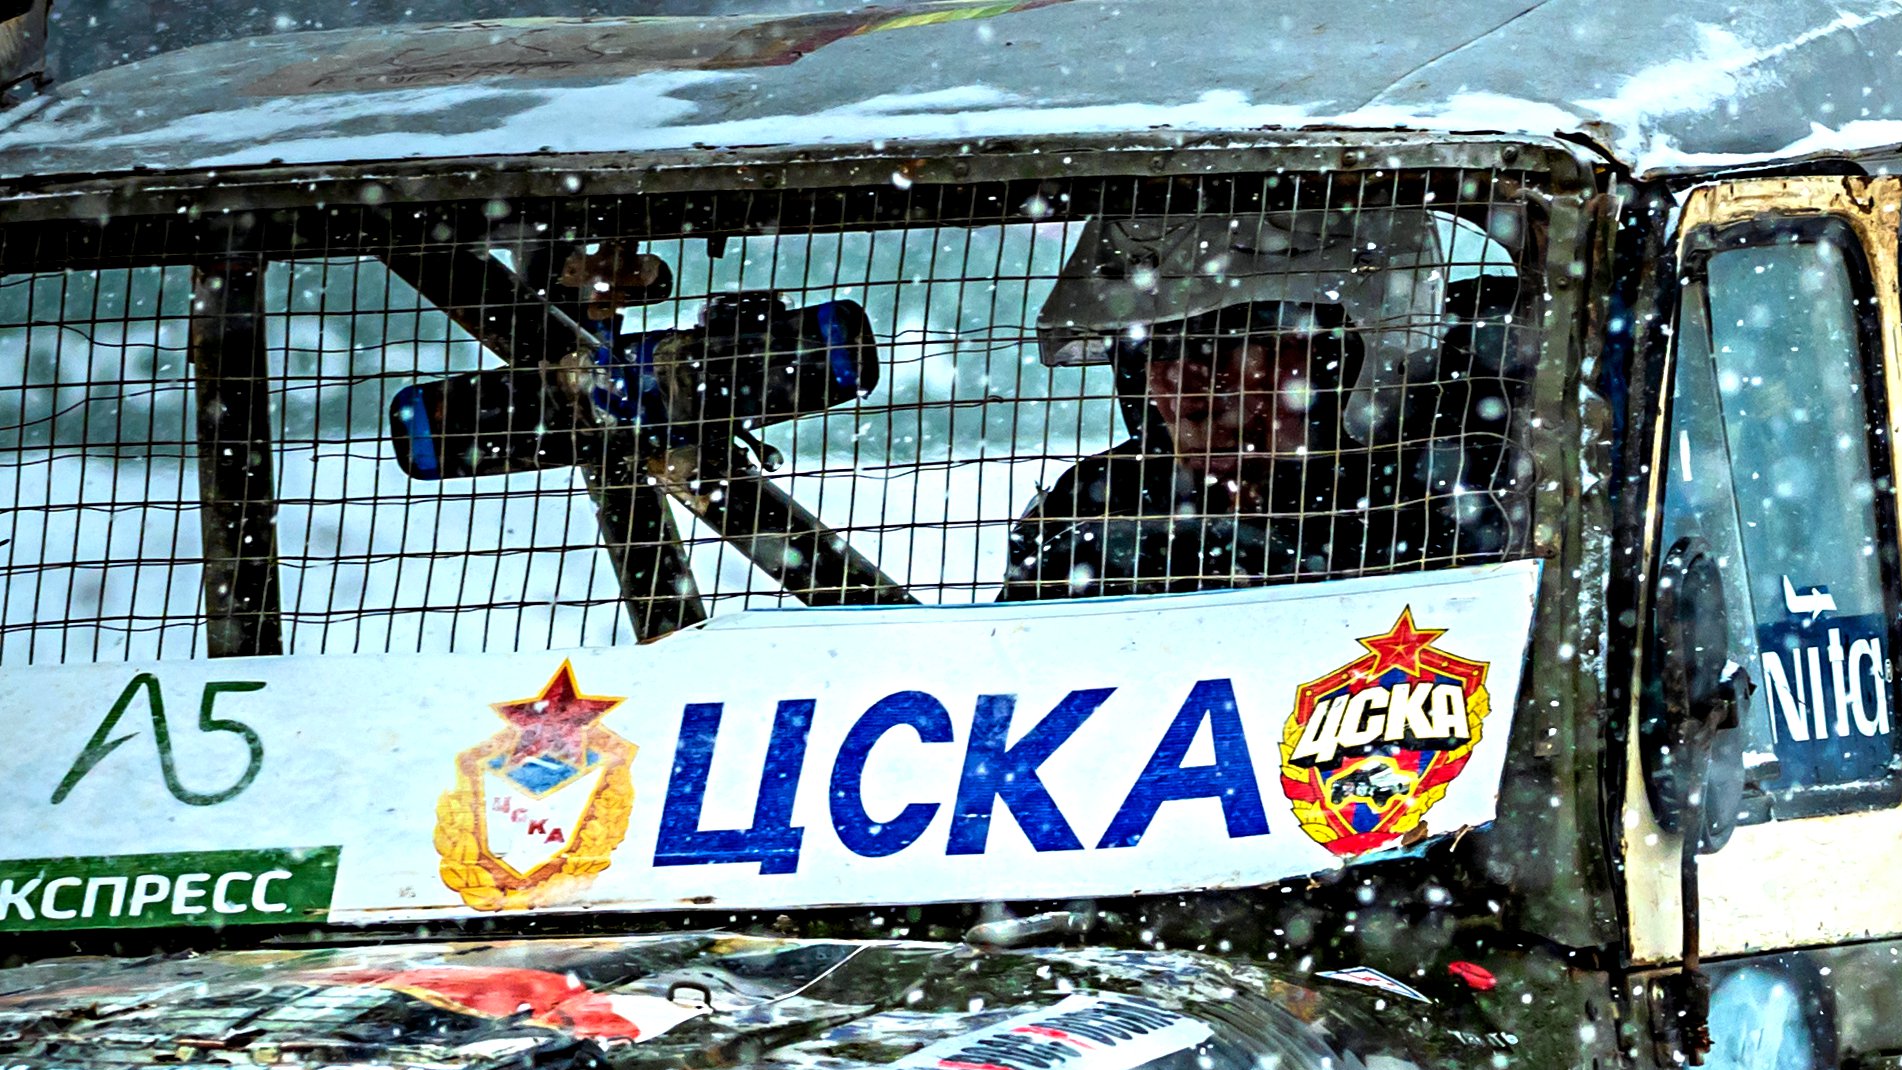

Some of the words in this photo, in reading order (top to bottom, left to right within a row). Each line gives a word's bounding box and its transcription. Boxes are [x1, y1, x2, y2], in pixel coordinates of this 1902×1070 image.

[1291, 682, 1472, 763] ЦСКА
[653, 678, 1270, 875] ЦСКА
[492, 796, 566, 844] ЦСКА
